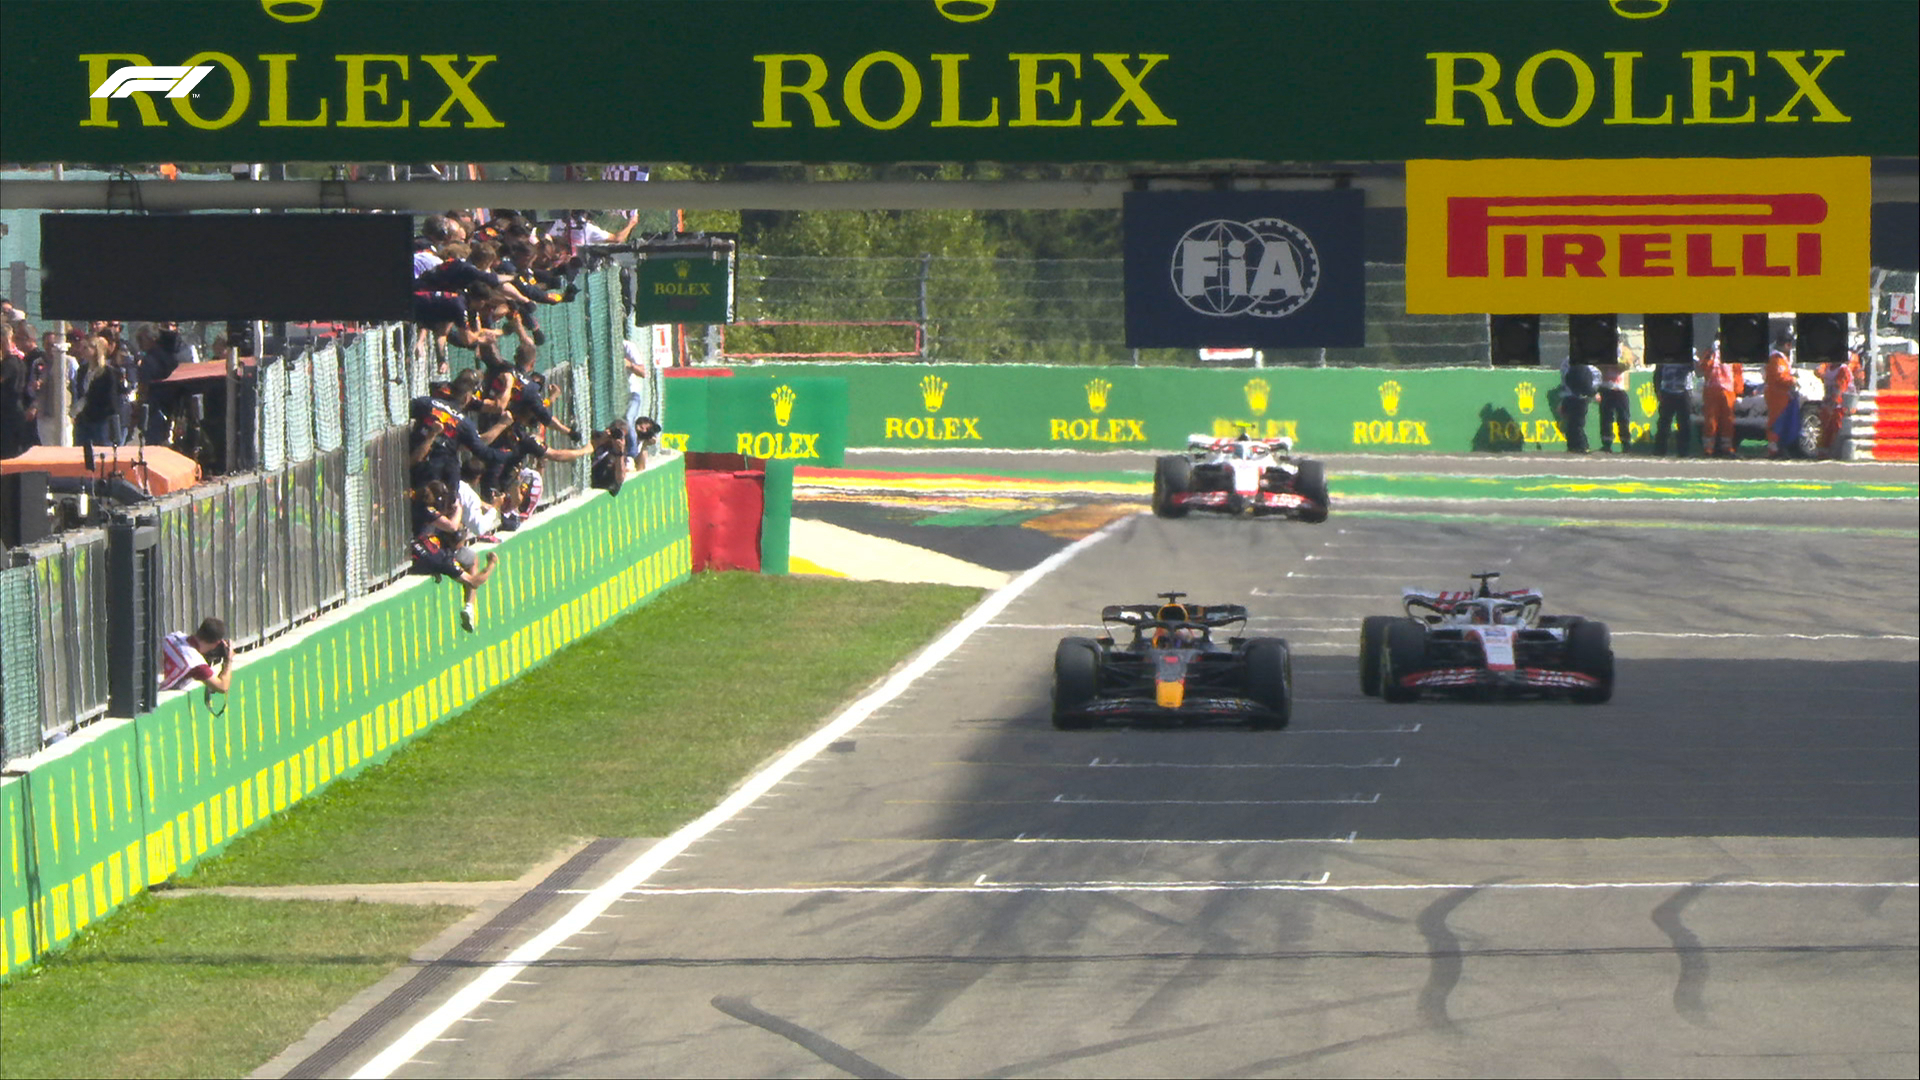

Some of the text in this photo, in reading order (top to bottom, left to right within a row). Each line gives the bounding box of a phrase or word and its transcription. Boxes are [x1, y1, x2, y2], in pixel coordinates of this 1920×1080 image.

[79, 51, 505, 130] ROLEX
[752, 50, 1178, 130] ROLEX
[1425, 49, 1852, 128] ROLEX
[1446, 192, 1829, 278] PIRELLI
[654, 282, 711, 296] ROLEX
[885, 416, 983, 441] ROLEX
[1050, 418, 1147, 443] ROLEX
[1353, 419, 1431, 446] ROLEX
[1488, 420, 1567, 444] ROLEX
[736, 431, 820, 460] ROLEX
